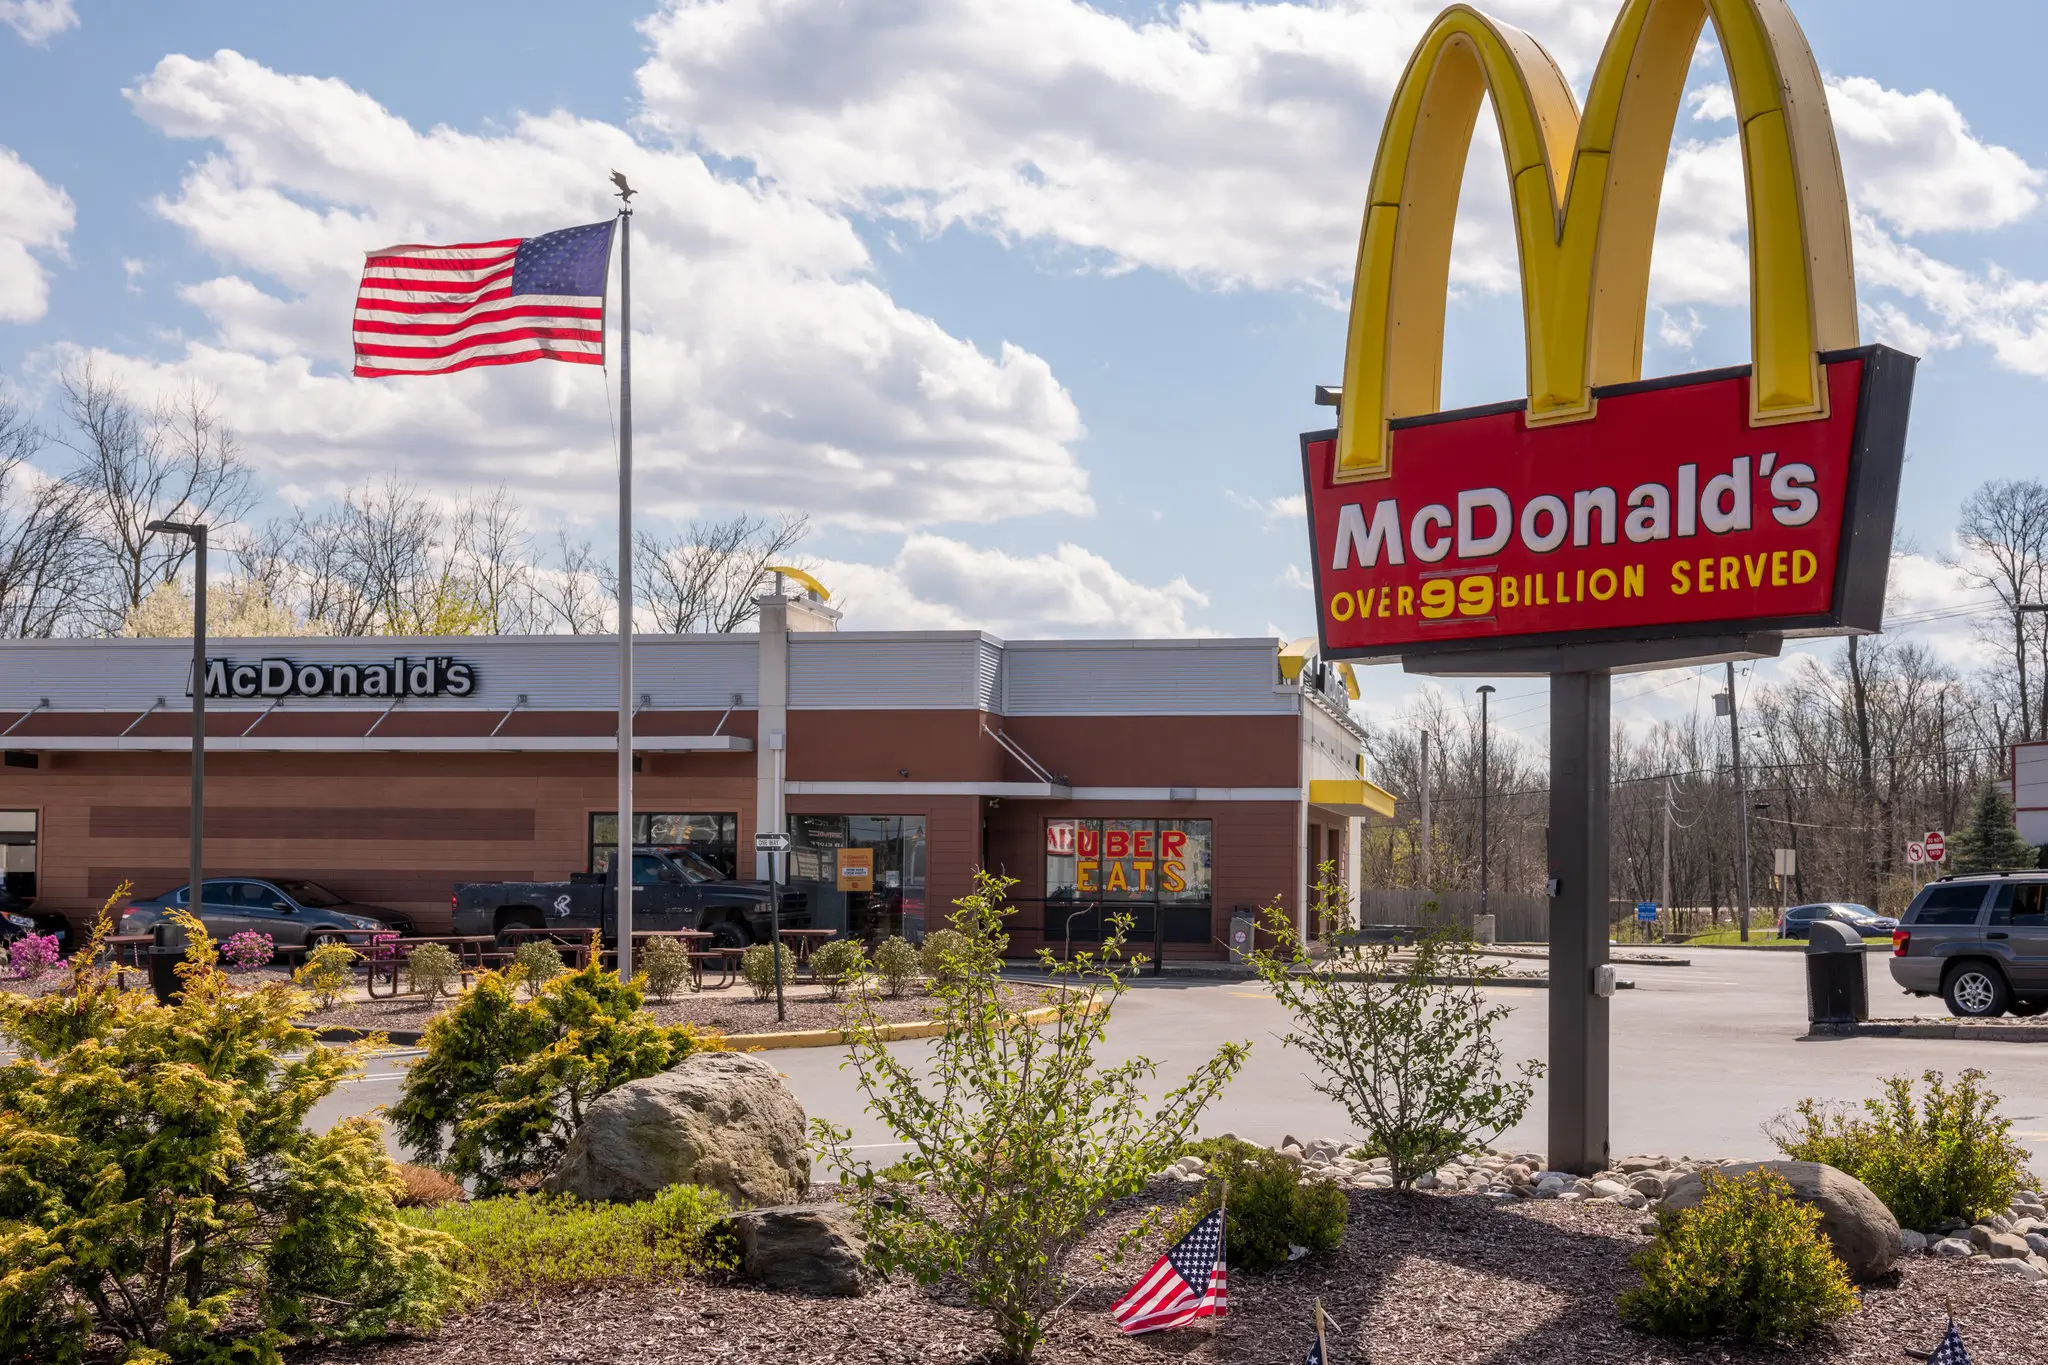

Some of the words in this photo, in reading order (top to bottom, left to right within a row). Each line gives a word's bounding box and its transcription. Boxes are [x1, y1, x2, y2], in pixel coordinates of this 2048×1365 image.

[1332, 452, 1820, 571] McDonald's
[1330, 587, 1415, 623] OVER
[1420, 575, 1494, 619] 99
[1500, 564, 1645, 608] BILLION
[1671, 549, 1818, 596] SERVED
[186, 657, 474, 697] McDonald's
[1077, 830, 1187, 858] UBER
[1077, 861, 1186, 892] EATS
